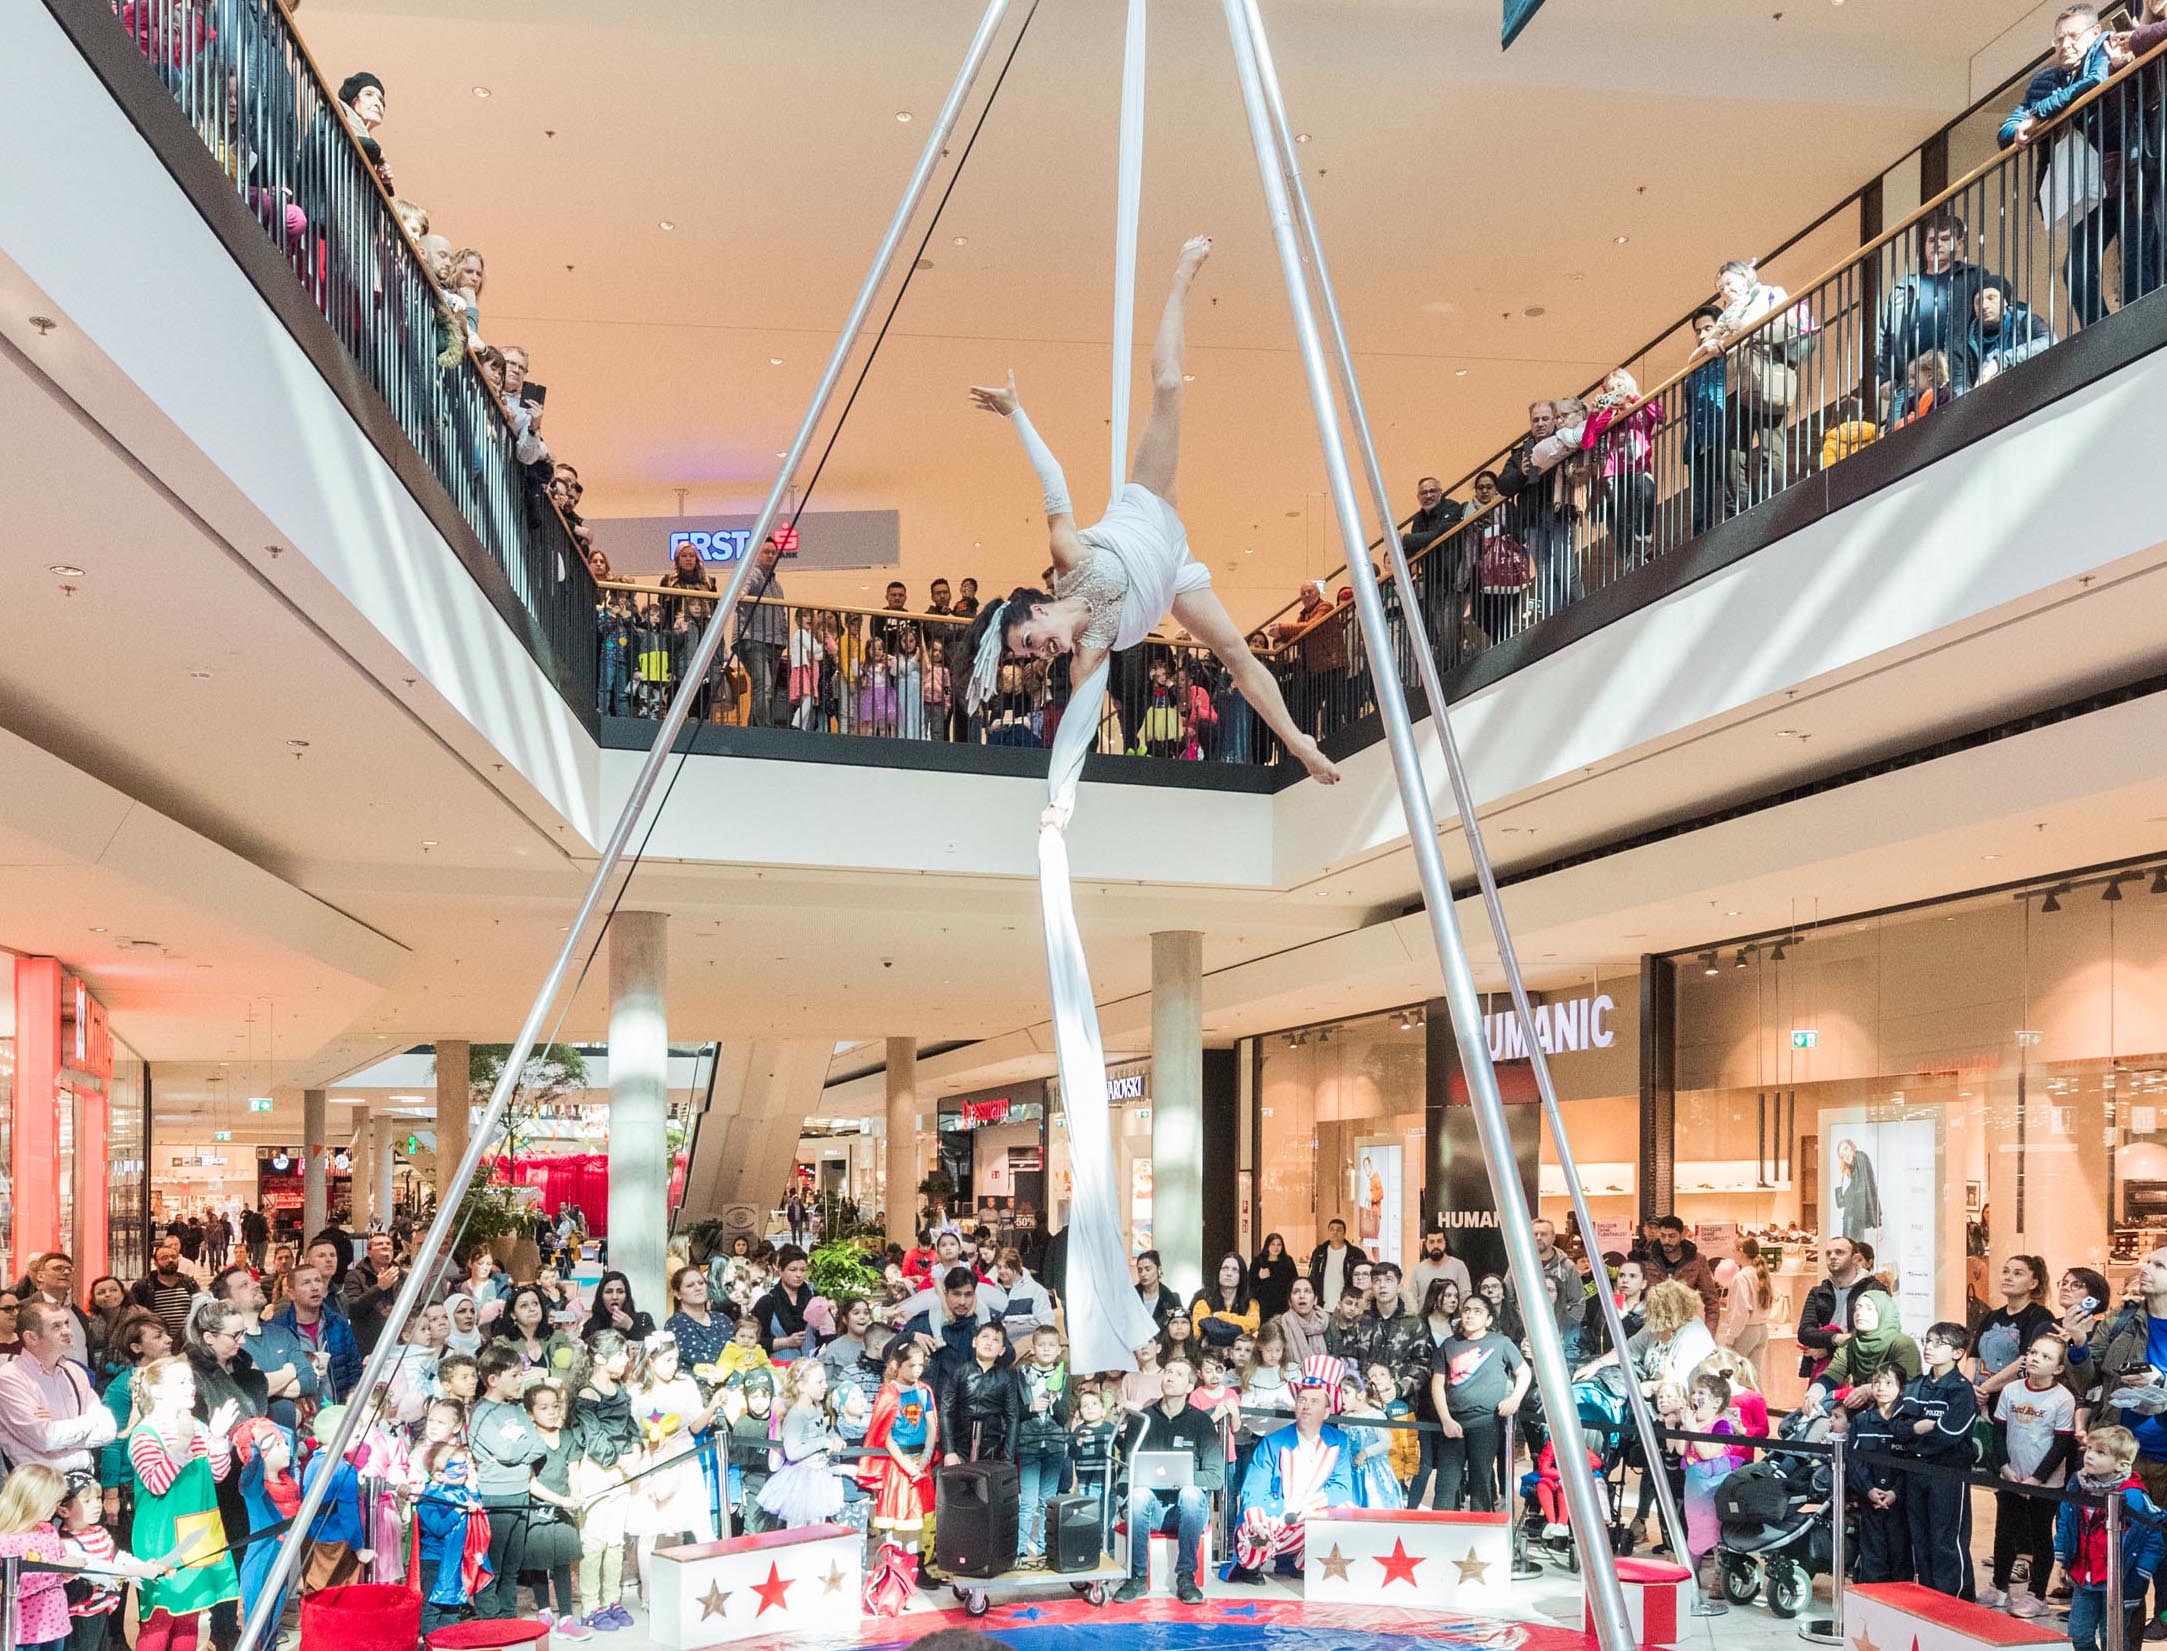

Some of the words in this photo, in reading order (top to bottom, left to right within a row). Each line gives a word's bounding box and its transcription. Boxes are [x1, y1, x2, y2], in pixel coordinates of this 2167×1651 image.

[669, 529, 752, 561] ERST
[778, 551, 798, 559] ANK
[1484, 995, 1615, 1062] UMANIC
[1107, 1076, 1142, 1100] AROVSKI
[1437, 1211, 1500, 1228] HUMA
